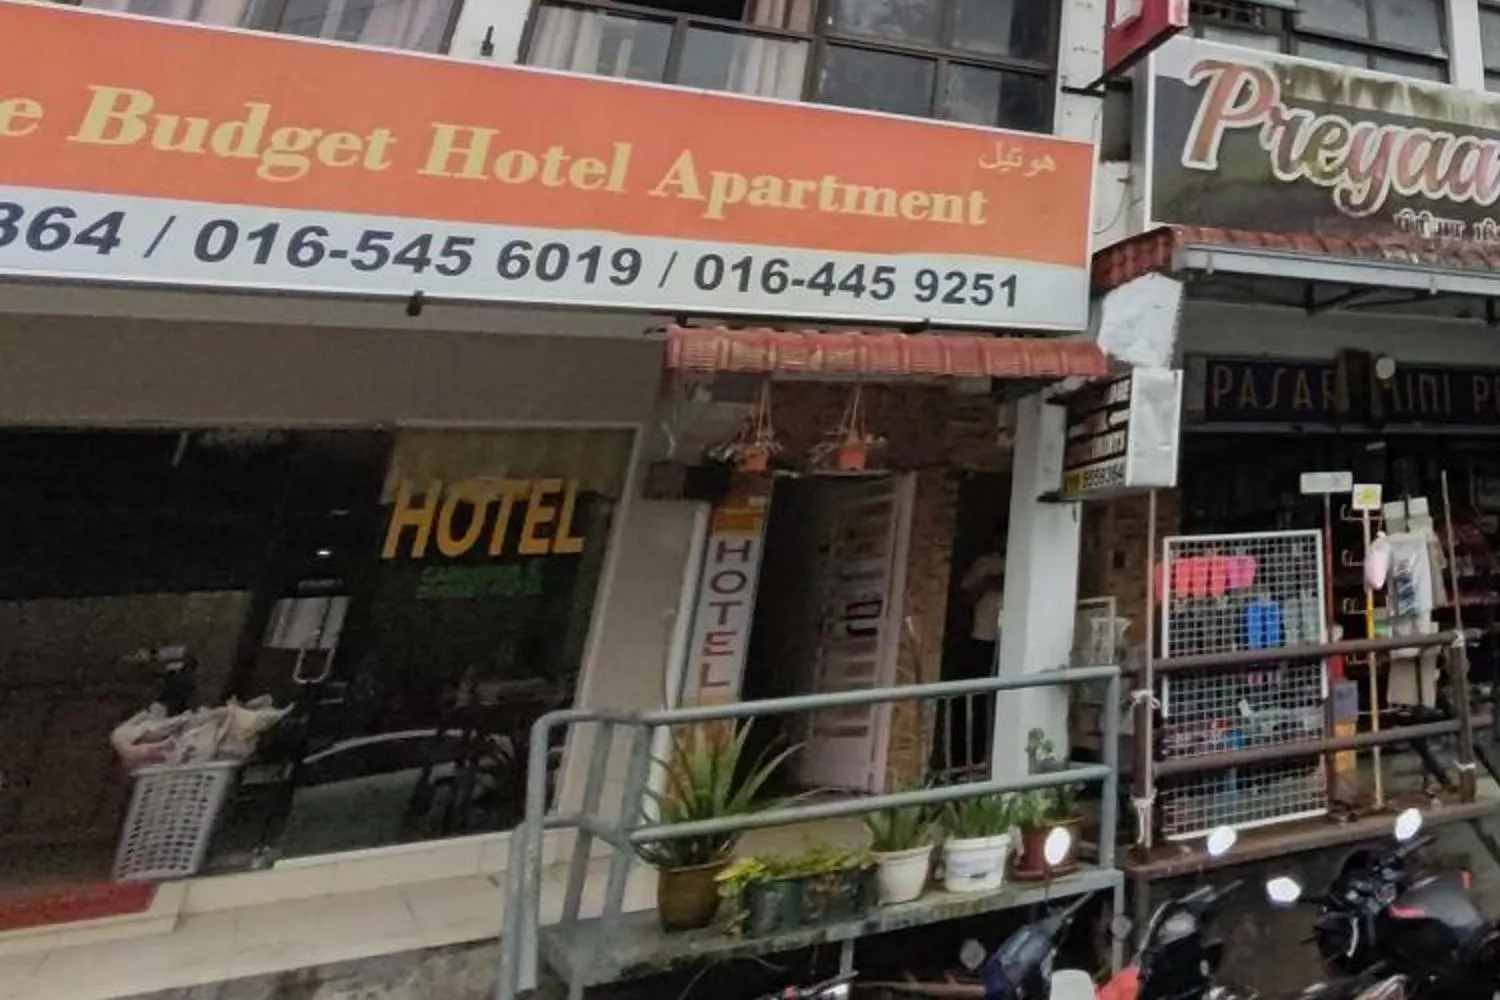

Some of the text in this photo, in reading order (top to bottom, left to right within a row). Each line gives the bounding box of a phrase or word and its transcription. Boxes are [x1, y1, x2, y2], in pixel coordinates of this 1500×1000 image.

[67, 84, 398, 183] Budget
[417, 121, 632, 192] Hotel
[648, 148, 989, 226] Apartment
[193, 218, 477, 278] 016-545
[496, 239, 642, 288] 6019
[693, 251, 897, 302] 016-445
[914, 268, 1019, 309] 9251
[381, 477, 586, 561] HOTEL
[699, 537, 756, 690] HOTEL
